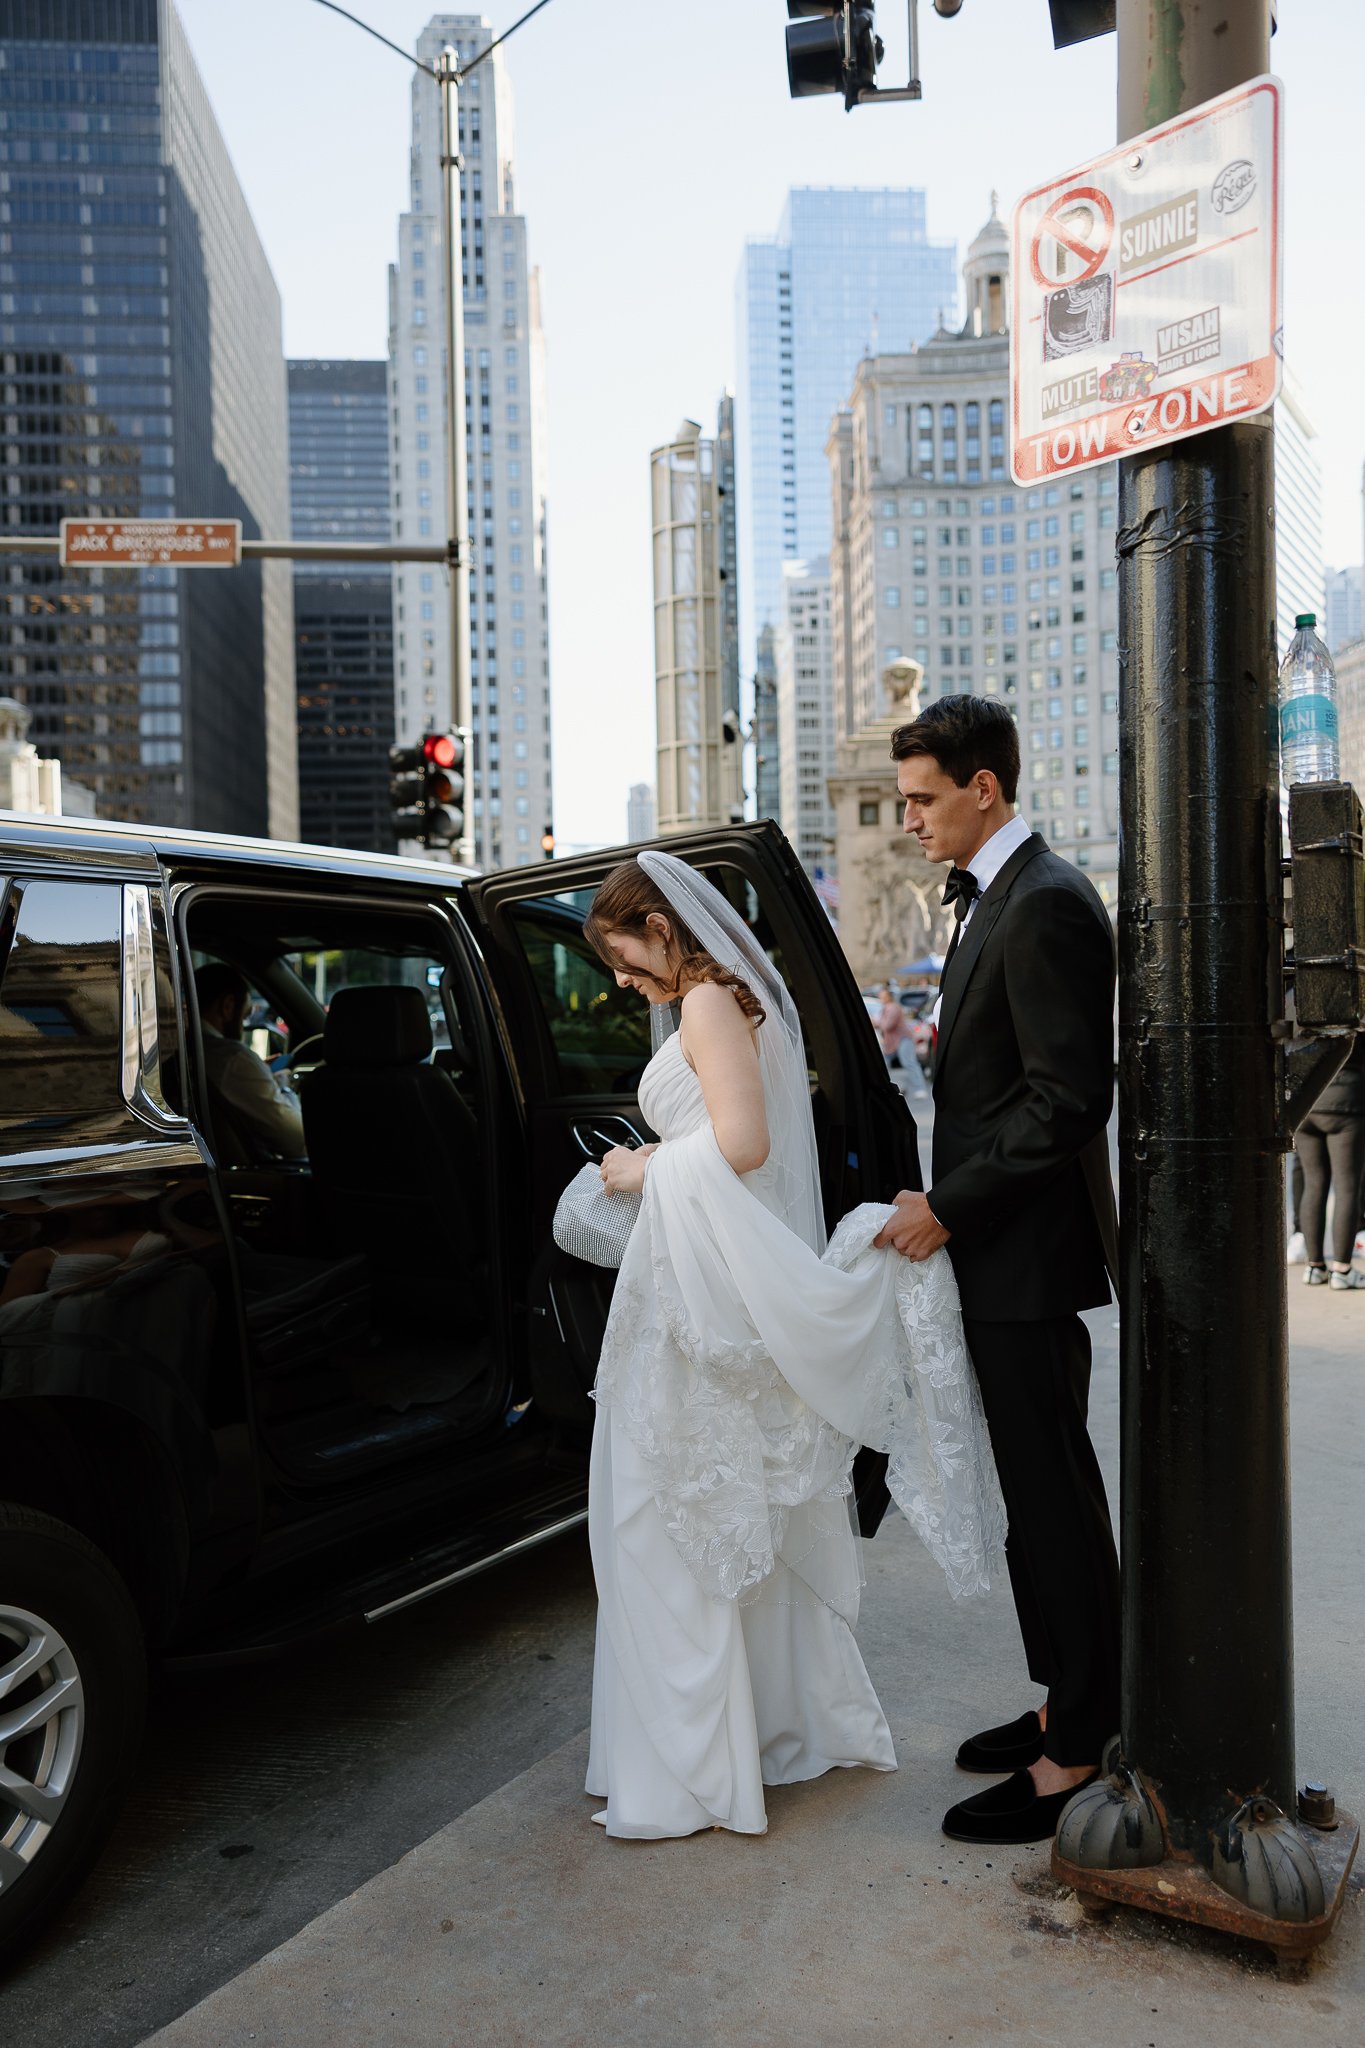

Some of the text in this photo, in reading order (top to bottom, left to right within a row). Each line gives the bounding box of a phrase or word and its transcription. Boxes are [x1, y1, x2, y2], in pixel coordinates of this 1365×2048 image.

[1212, 100, 1254, 125] CHICAGO
[1121, 200, 1197, 263] SUNNIE
[1158, 309, 1219, 354] VISAH
[1159, 355, 1185, 374] MADE
[1185, 352, 1193, 365] U
[1194, 341, 1219, 362] LOOK
[1042, 370, 1097, 413] MUTE
[1029, 369, 1250, 472] TOW ZONE
[70, 535, 231, 551] JACK BRICKHOUSE WAY
